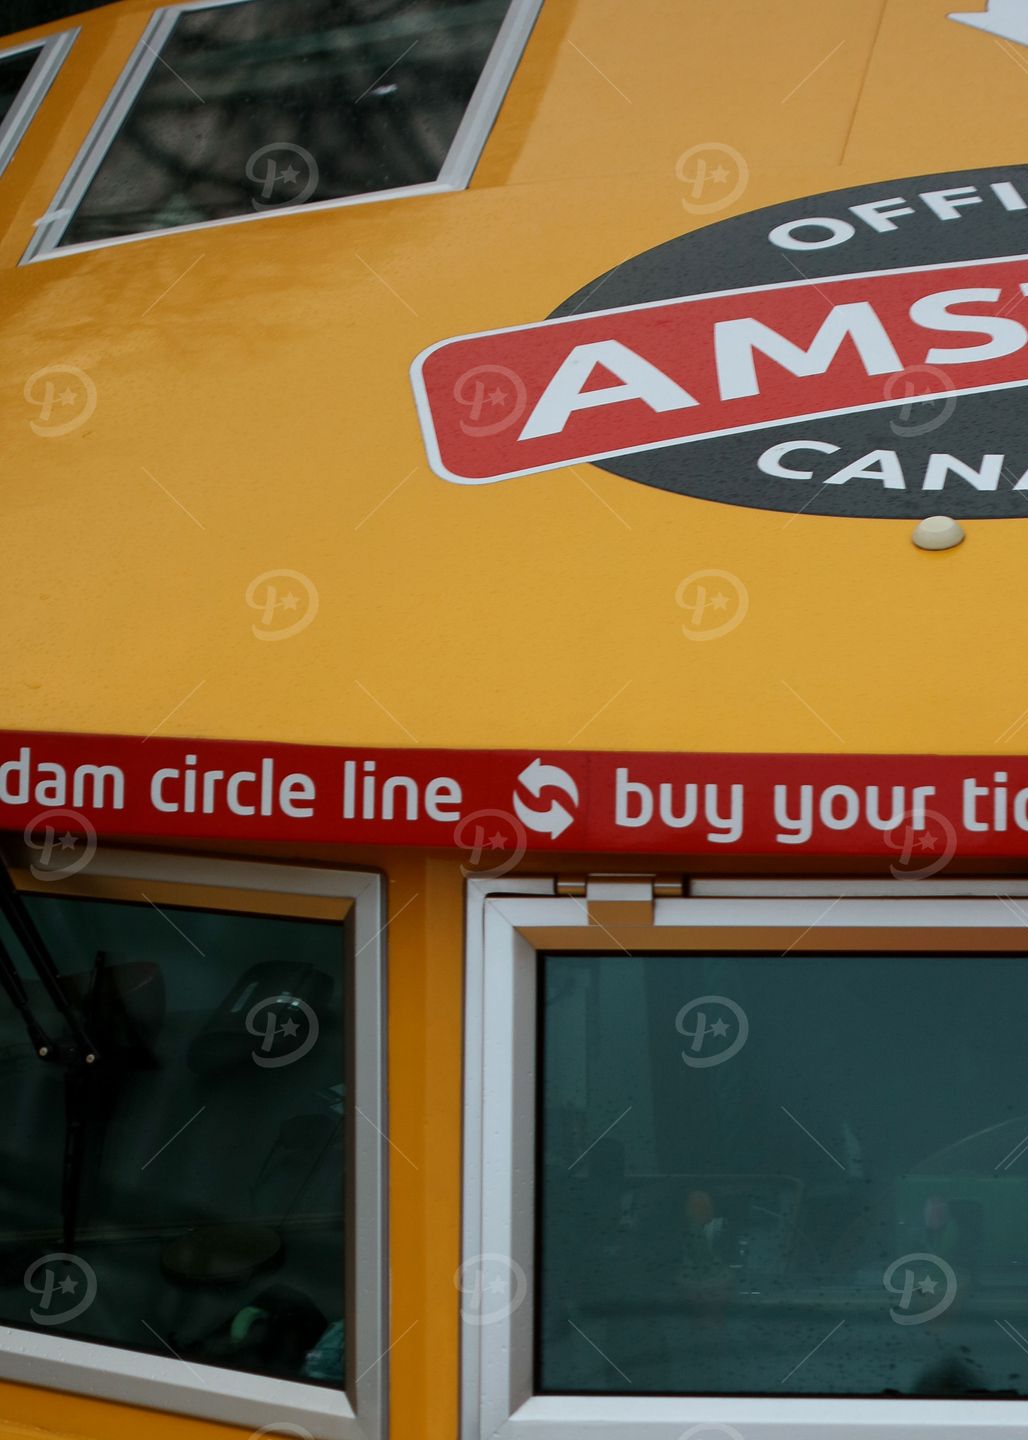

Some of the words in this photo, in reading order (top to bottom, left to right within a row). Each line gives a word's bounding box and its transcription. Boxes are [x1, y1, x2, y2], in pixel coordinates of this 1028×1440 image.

[0, 746, 125, 810] dam
[149, 755, 316, 818] circle
[342, 759, 463, 822] line
[614, 766, 745, 844] buy
[773, 783, 936, 845] your
